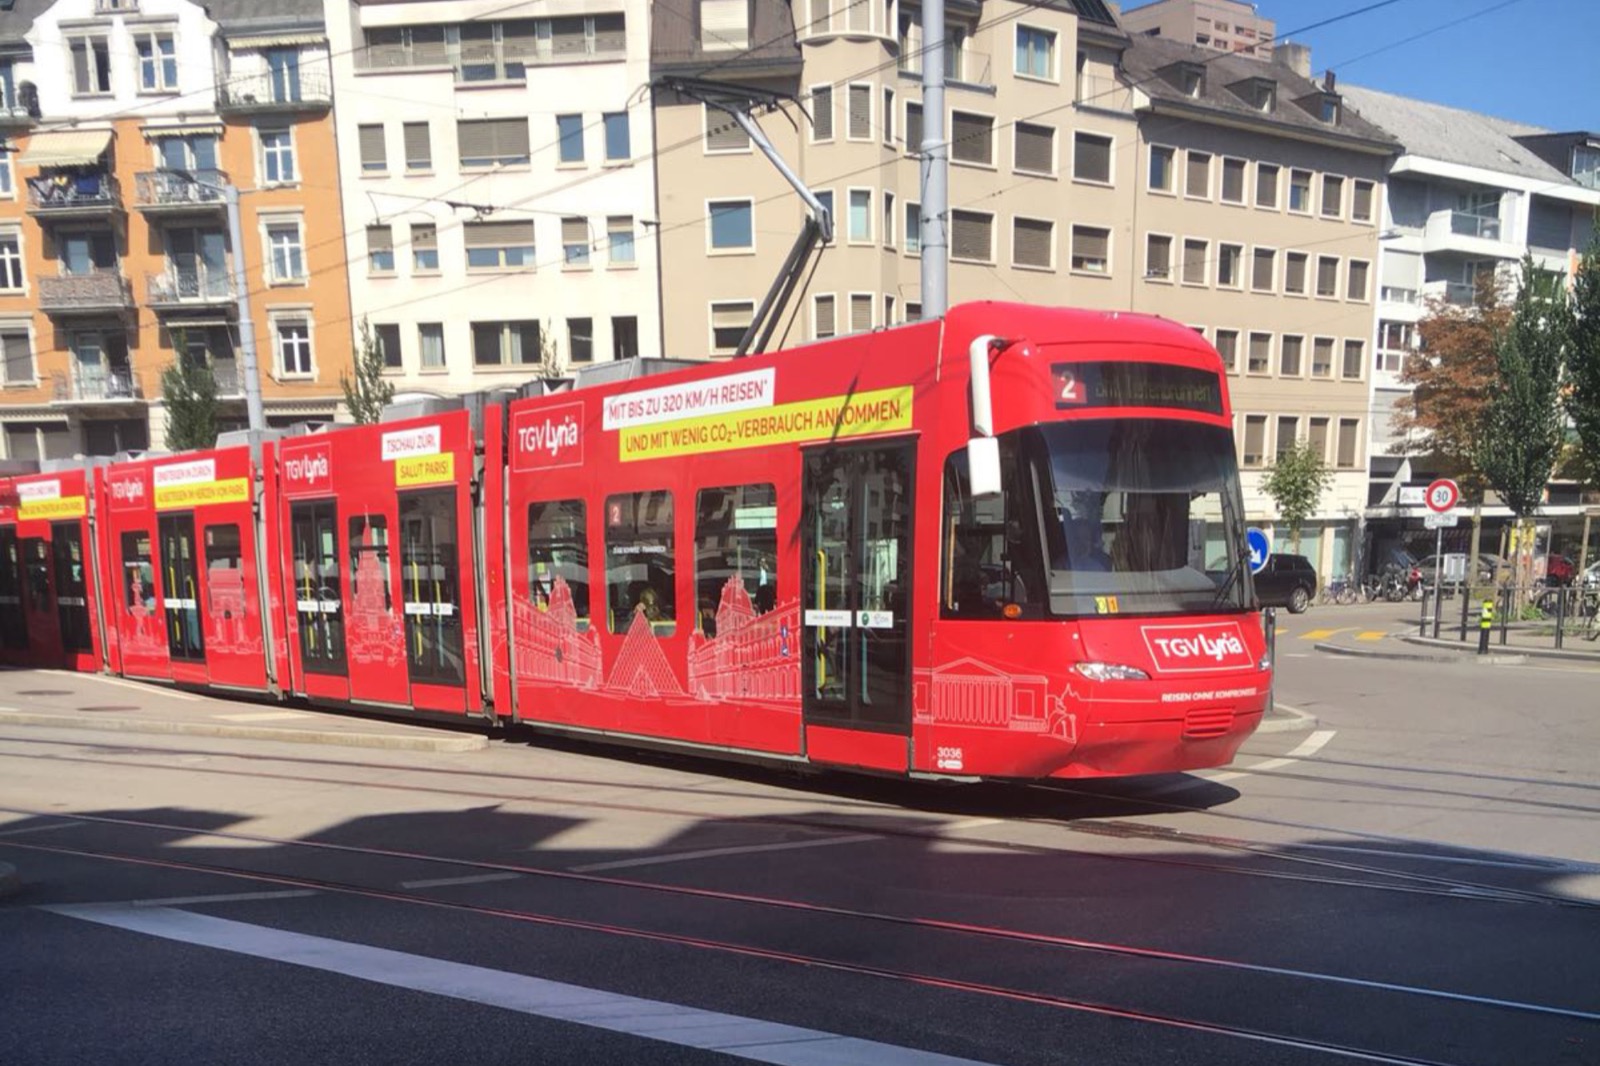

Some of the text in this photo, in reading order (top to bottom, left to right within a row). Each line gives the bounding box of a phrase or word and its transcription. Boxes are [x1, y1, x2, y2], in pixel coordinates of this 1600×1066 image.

[1060, 371, 1077, 399] 2
[608, 404, 626, 421] MIT
[628, 401, 644, 418] BIS
[646, 398, 661, 415] ZU
[662, 394, 683, 413] 320
[685, 388, 719, 410] KM/H
[518, 425, 545, 453] TGV
[626, 435, 649, 453] UND
[650, 431, 669, 449] MIT
[671, 426, 708, 446] WENIG
[815, 399, 903, 429] ANKOMMEN.
[387, 437, 415, 452] TSCHAU
[285, 459, 304, 480] TGV
[400, 463, 424, 479] SALUT
[1435, 490, 1449, 504] 30
[1154, 632, 1243, 661] TGV Lyria
